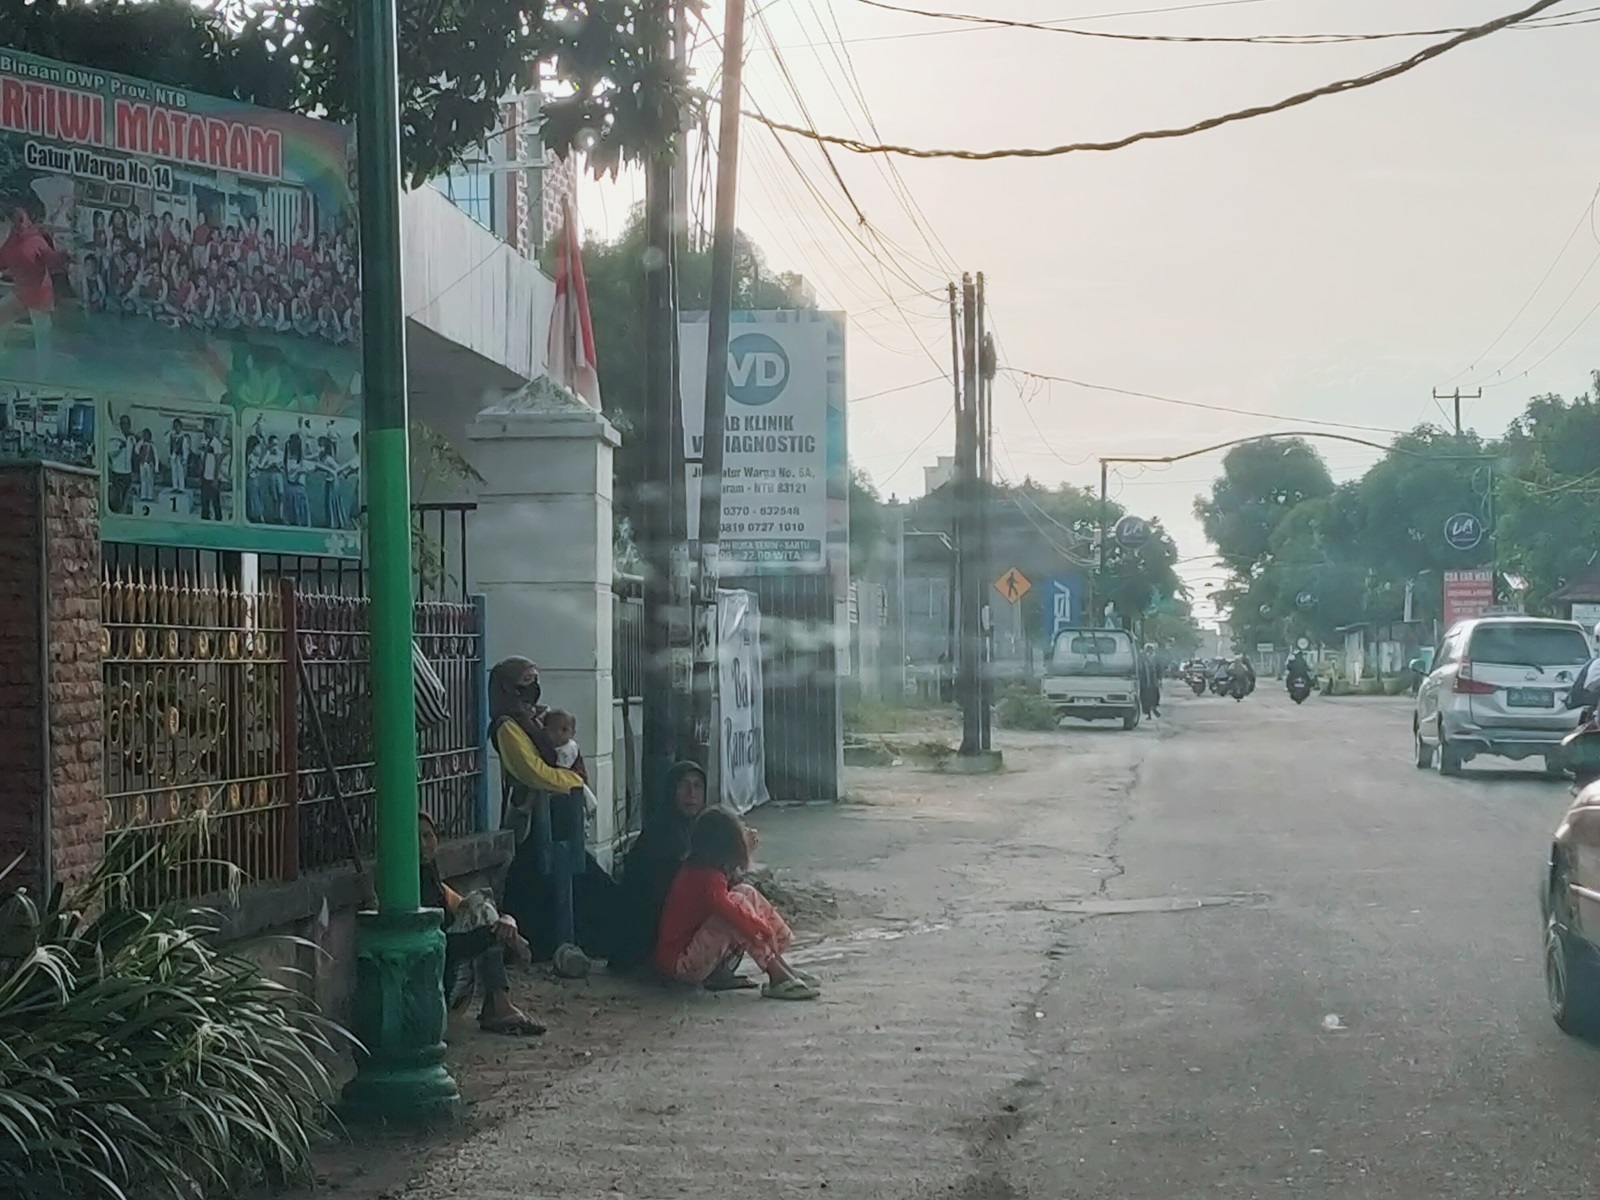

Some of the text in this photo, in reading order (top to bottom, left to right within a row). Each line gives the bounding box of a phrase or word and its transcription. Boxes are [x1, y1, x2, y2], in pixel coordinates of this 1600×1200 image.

[66, 70, 104, 88] DWP
[156, 88, 187, 107] NTB
[0, 75, 282, 179] RTIWI MATARAM
[25, 143, 172, 189] Catur Warga No. 14
[728, 352, 785, 387] VD
[745, 415, 794, 431] KLINIK
[725, 435, 815, 453] IAGNOSTIC
[754, 482, 774, 494] NTB
[723, 506, 749, 516] 0370
[748, 523, 774, 532] 0727
[779, 523, 805, 532] 1010
